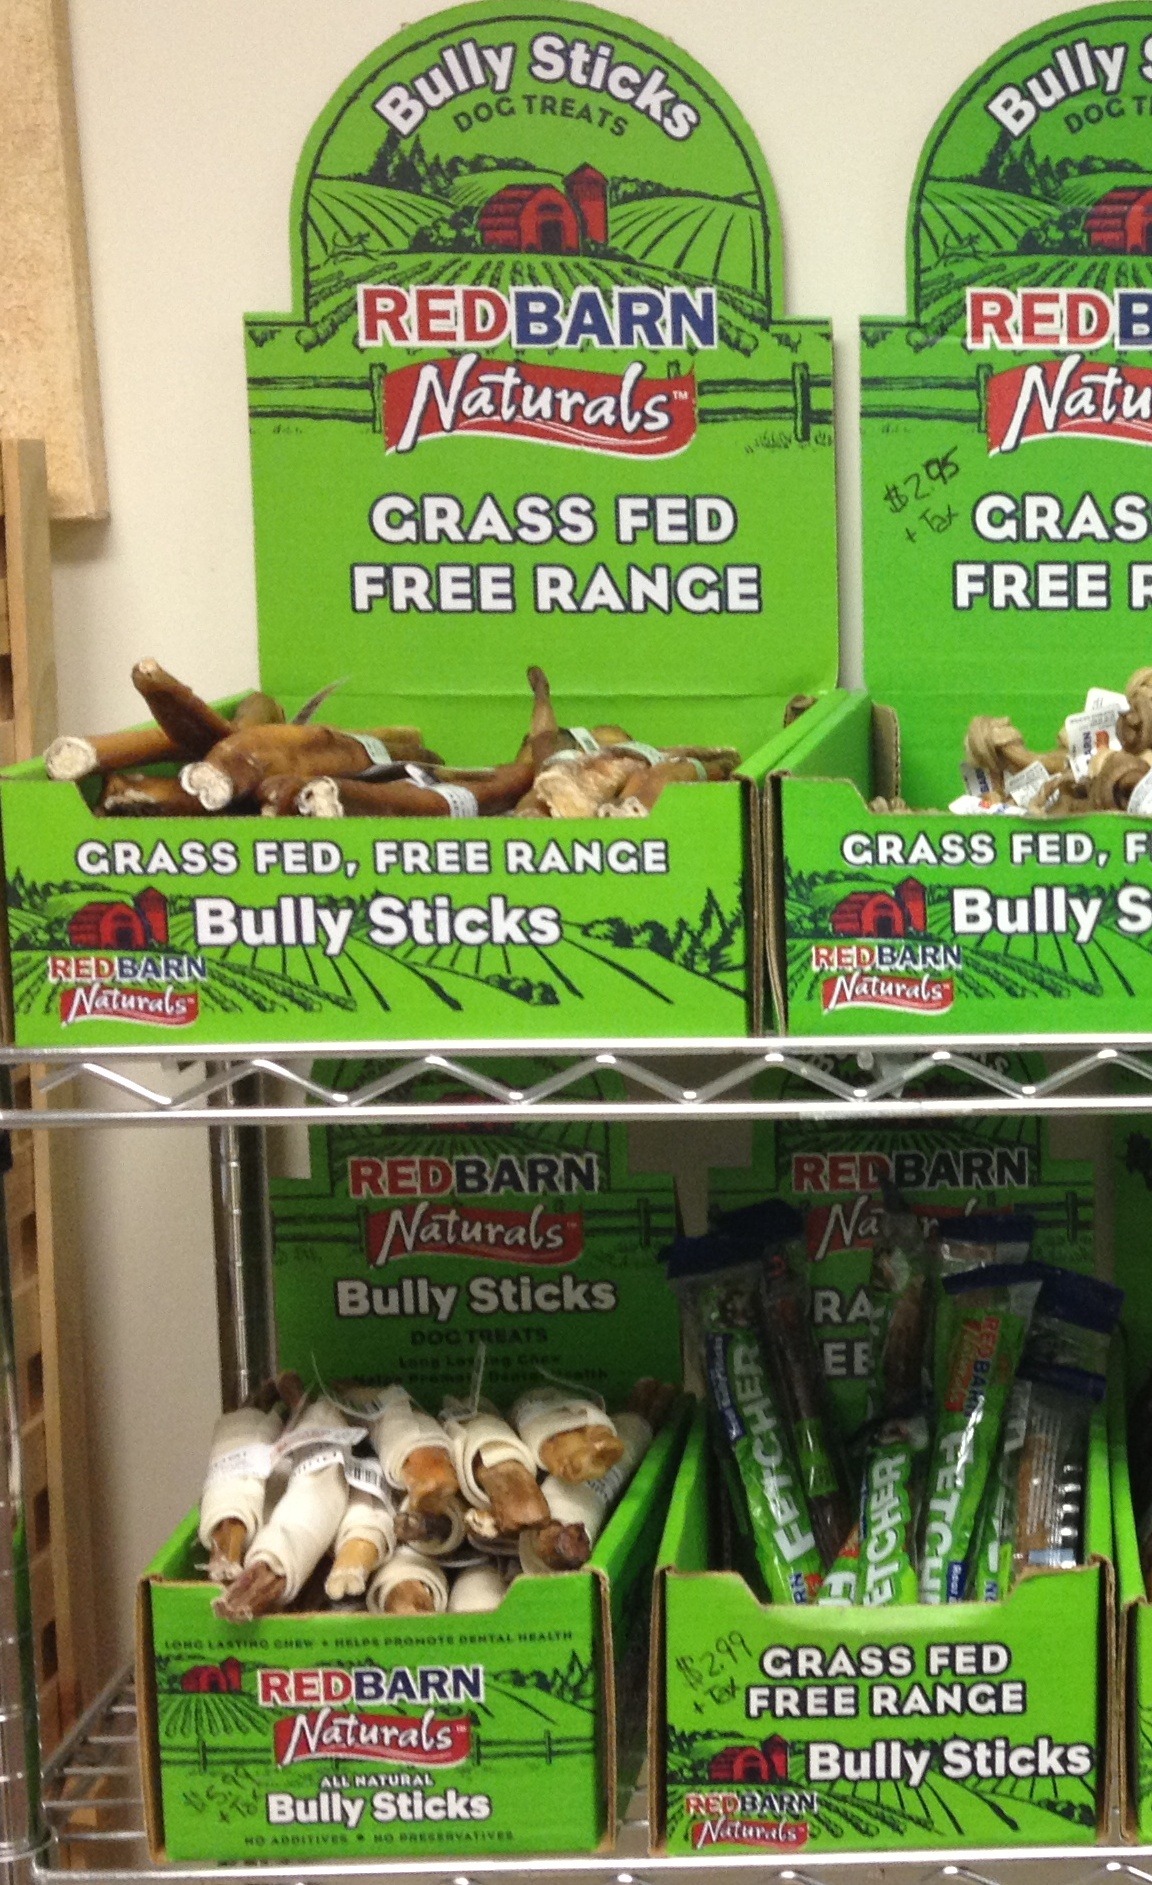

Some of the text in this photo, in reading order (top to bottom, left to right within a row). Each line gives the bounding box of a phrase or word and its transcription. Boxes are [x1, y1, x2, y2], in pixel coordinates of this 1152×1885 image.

[374, 33, 700, 142] Bully Sticks
[987, 41, 1127, 139] Bully
[453, 94, 631, 138] DOG TREATS
[1062, 97, 1125, 134] DOG
[356, 285, 718, 349] REDBARN
[370, 494, 737, 544] GRASS FED
[918, 504, 958, 533] Tax
[352, 564, 762, 613] FREE RANGE
[954, 563, 1110, 610] FREE
[75, 841, 239, 875] GRASS
[373, 841, 493, 876] FREE
[506, 840, 670, 876] RANGE
[841, 833, 997, 866] GRASS
[196, 896, 562, 956] Bully Sticks
[951, 886, 1101, 943] Bully
[47, 955, 208, 982] REDBARN
[811, 945, 963, 972] REDBARN
[348, 1153, 599, 1200] REDBARN
[791, 1147, 1029, 1192] REDBARN
[335, 1274, 618, 1322] Bully Sticks
[409, 1326, 549, 1346] DOG TREATS
[733, 1342, 816, 1562] FETCHER
[863, 1451, 906, 1607] ETCHER
[920, 1430, 974, 1604] FETCH
[165, 1631, 573, 1650] LONG LASTING CHEW HELPS PROMOTE DENTAL HEALTH
[759, 1642, 1011, 1679] GRASS FED
[257, 1663, 484, 1707] REDBARN
[704, 1677, 740, 1705] Tax
[746, 1682, 1026, 1719] FREE RANGE
[321, 1773, 434, 1788] ALL NATURAL
[808, 1738, 1093, 1787] Bully Sticks
[267, 1788, 491, 1829] Bully Sticks
[685, 1793, 818, 1815] REDBARN
[244, 1831, 514, 1846] NO ADDITIVES NO PRESERVATIVES
